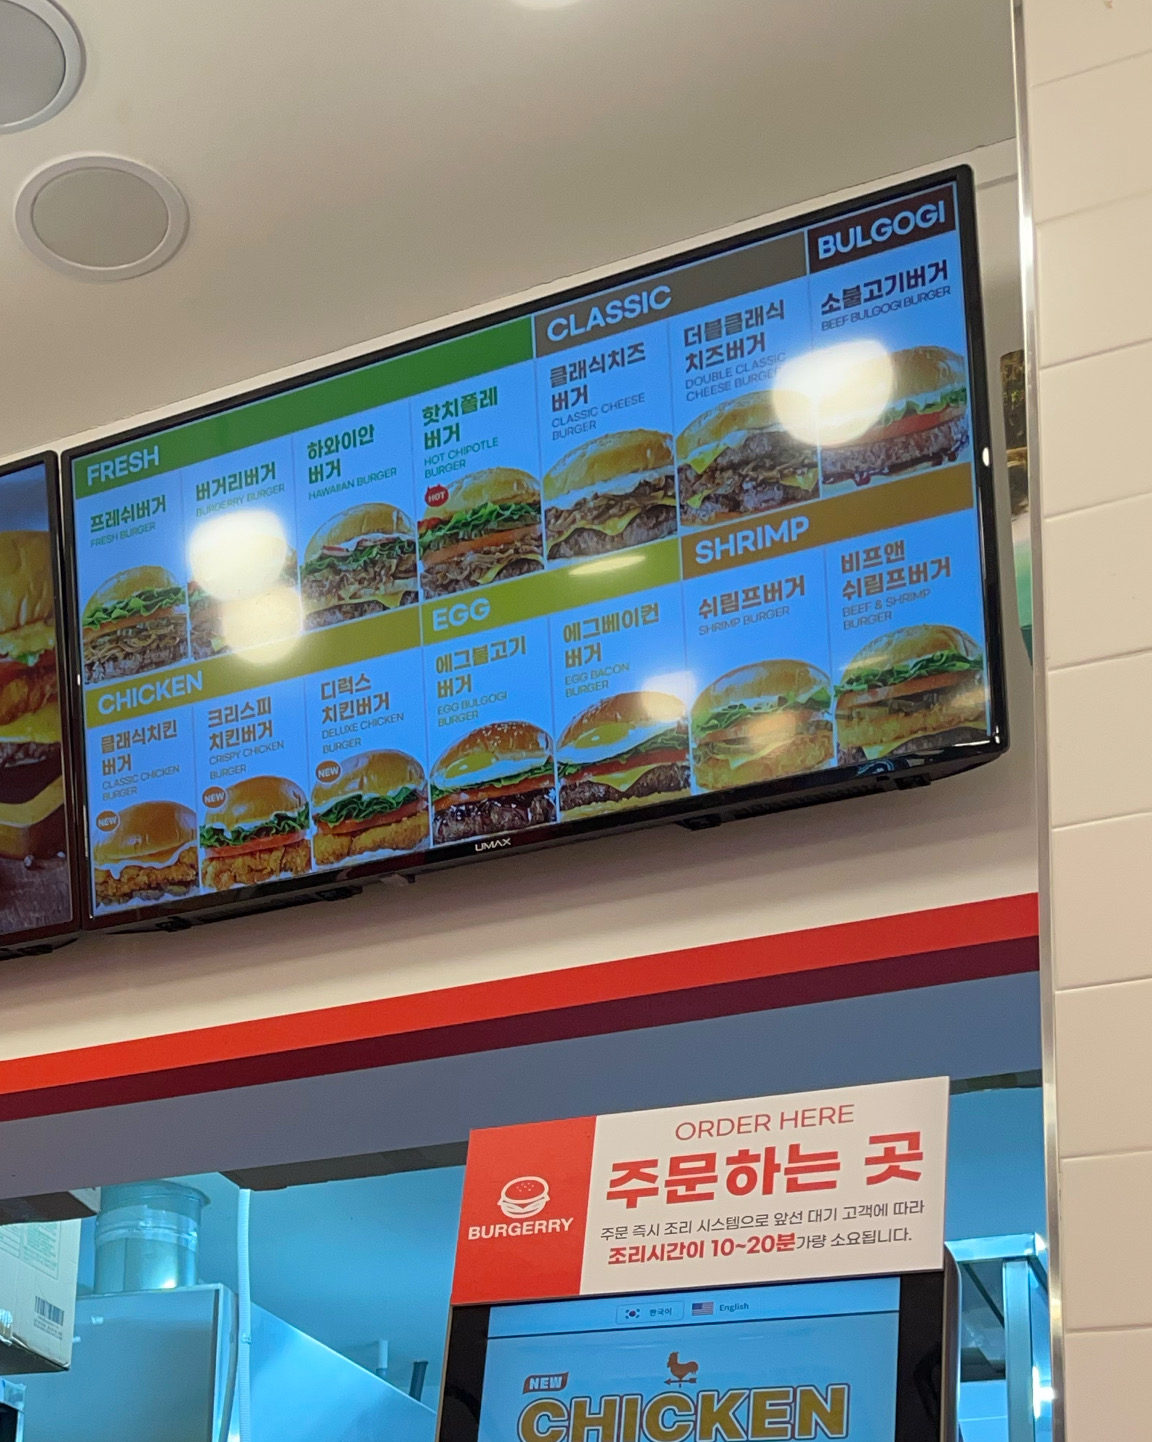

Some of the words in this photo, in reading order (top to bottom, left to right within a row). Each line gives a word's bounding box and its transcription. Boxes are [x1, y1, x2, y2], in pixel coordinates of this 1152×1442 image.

[817, 201, 946, 260] BULGOGI
[821, 260, 949, 315] 소불고기버거
[547, 285, 672, 342] CLASSIC
[822, 317, 849, 332] BEEF
[850, 300, 903, 324] BULGOGI
[904, 286, 951, 307] BURGER
[684, 300, 785, 348] 더블클래식
[549, 343, 646, 388] 클래식치즈
[685, 332, 766, 373] 치즈버거
[686, 367, 733, 389] DOUBLE
[736, 353, 786, 374] CLASSIC
[551, 384, 589, 412] 버거
[686, 382, 731, 401] CHEESE
[552, 406, 599, 428] CLASSIC
[601, 392, 646, 416] CHEESE
[307, 424, 375, 461] 하와이안
[424, 423, 460, 450] 버거
[552, 421, 597, 440] BURGER
[424, 453, 445, 466] HOT
[448, 437, 498, 460] CHIPOTLE
[86, 446, 160, 487] FRESH
[309, 459, 341, 485] 버거
[356, 467, 397, 490] BURGER
[425, 460, 466, 478] BURGER
[195, 461, 276, 502] 버거리버거
[247, 484, 285, 502] BURGER
[428, 491, 445, 502] HOT
[90, 495, 166, 533] 프레쉬버거
[120, 522, 156, 540] BURGER
[695, 516, 809, 564] SHRIMP
[841, 540, 905, 573] 비프앤
[842, 557, 951, 600] 쉬림프버거
[699, 576, 805, 619] 쉬림프버거
[842, 602, 872, 618] BEEF
[885, 589, 930, 609] SHRIMP
[432, 598, 491, 631] EGG
[563, 603, 659, 643] 에그베이컨
[699, 617, 740, 635] SHRIMP
[744, 606, 790, 627] BURGER
[844, 610, 892, 631] BURGER
[436, 636, 526, 674] 에그불고기
[565, 643, 601, 669] 버거
[320, 674, 371, 700] 디럭스
[437, 674, 472, 699] 버거
[565, 670, 587, 685] EGG
[590, 663, 630, 681] BACON
[565, 680, 608, 697] BURGER
[98, 671, 203, 714] CHICKEN
[208, 697, 272, 728] 크리스피
[322, 692, 390, 724] 치킨버거
[438, 701, 459, 715] EGG
[438, 710, 479, 727] BURGER
[101, 719, 177, 753] 클래식치킨
[209, 720, 273, 752] 치킨버거
[322, 723, 358, 739] DELUXE
[360, 713, 404, 732] CHICKEN
[210, 751, 241, 765] CRISPY
[243, 740, 284, 757] CHICKEN
[323, 737, 361, 753] BURGER
[102, 753, 131, 776] 버거
[210, 764, 246, 779] BURGER
[317, 765, 341, 778] NEW
[205, 793, 224, 803] NEW
[99, 817, 117, 827] NEW
[475, 838, 511, 852] UMAX
[675, 1114, 772, 1141] ORDER
[779, 1104, 855, 1131] HERE
[606, 1143, 841, 1209] 주문하는
[865, 1131, 924, 1186] 곳
[467, 1218, 574, 1240] BURGERRY
[601, 1226, 628, 1241] 주문
[632, 1223, 660, 1239] 즉시
[664, 1219, 693, 1236] 조리
[697, 1213, 770, 1234] 시스템으로
[774, 1209, 804, 1227] 앞선
[808, 1206, 838, 1225] 대기
[843, 1203, 888, 1222] 고객에
[893, 1200, 924, 1218] 따라
[608, 1240, 705, 1265] 조리시간이
[831, 1227, 912, 1248] 소요됩니다.
[650, 1308, 672, 1316] 한국어
[720, 1303, 749, 1312] English
[529, 1376, 563, 1390] NEW
